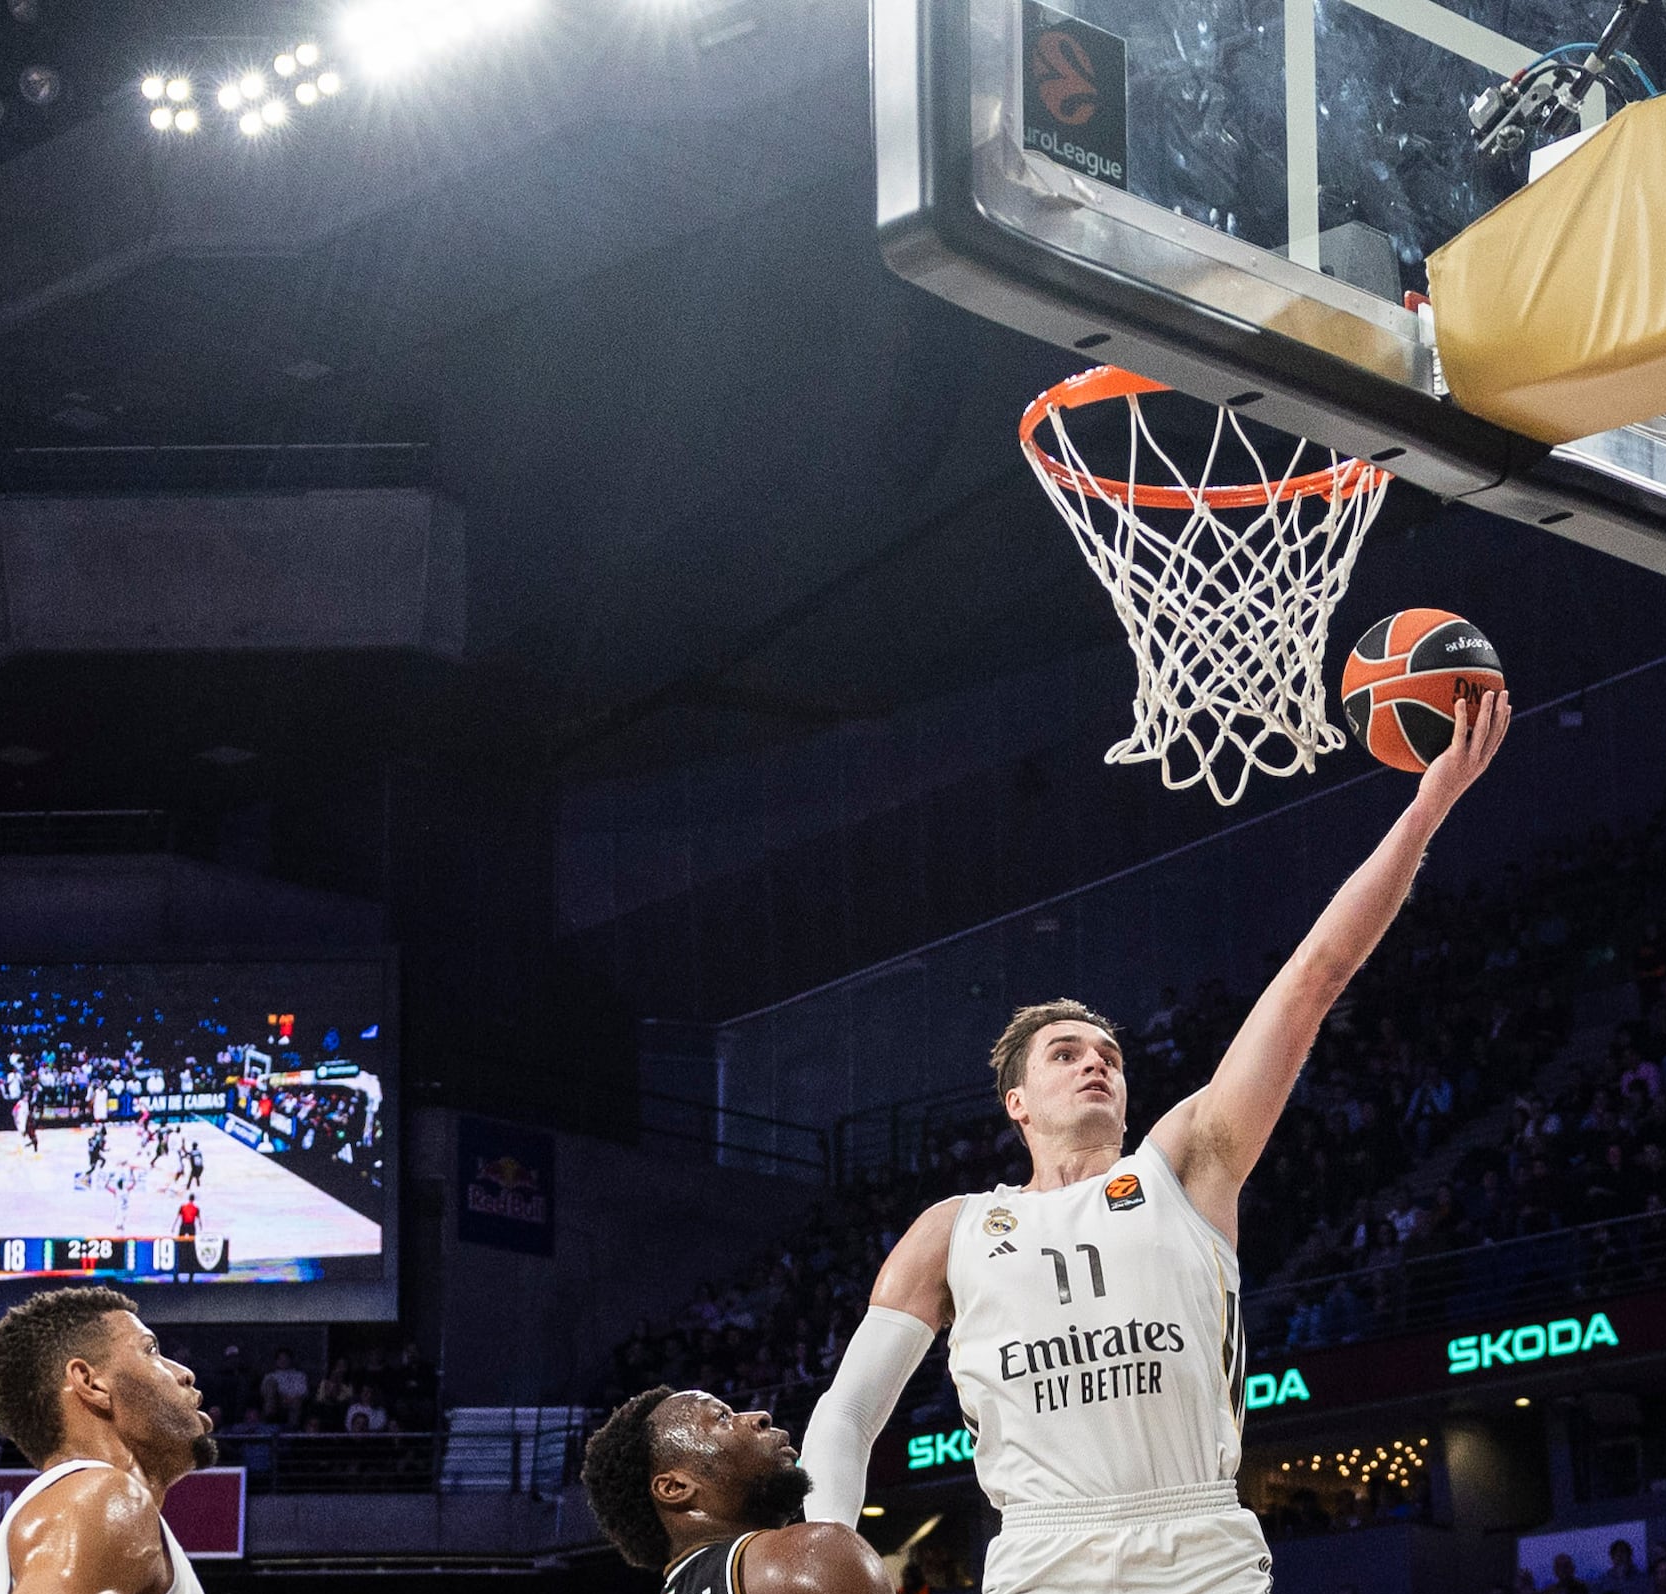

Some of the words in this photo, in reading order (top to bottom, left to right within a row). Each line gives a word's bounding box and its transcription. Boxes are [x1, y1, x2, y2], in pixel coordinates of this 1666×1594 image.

[1023, 126, 1123, 180] roLeague
[3, 1239, 26, 1272] 18
[68, 1239, 113, 1259] 2:28
[153, 1238, 176, 1271] 19
[1041, 1243, 1106, 1305] 11
[999, 1318, 1185, 1381] Emirates
[1034, 1374, 1070, 1414] FLY
[1080, 1360, 1163, 1405] BETTER
[908, 1429, 975, 1470] SKO
